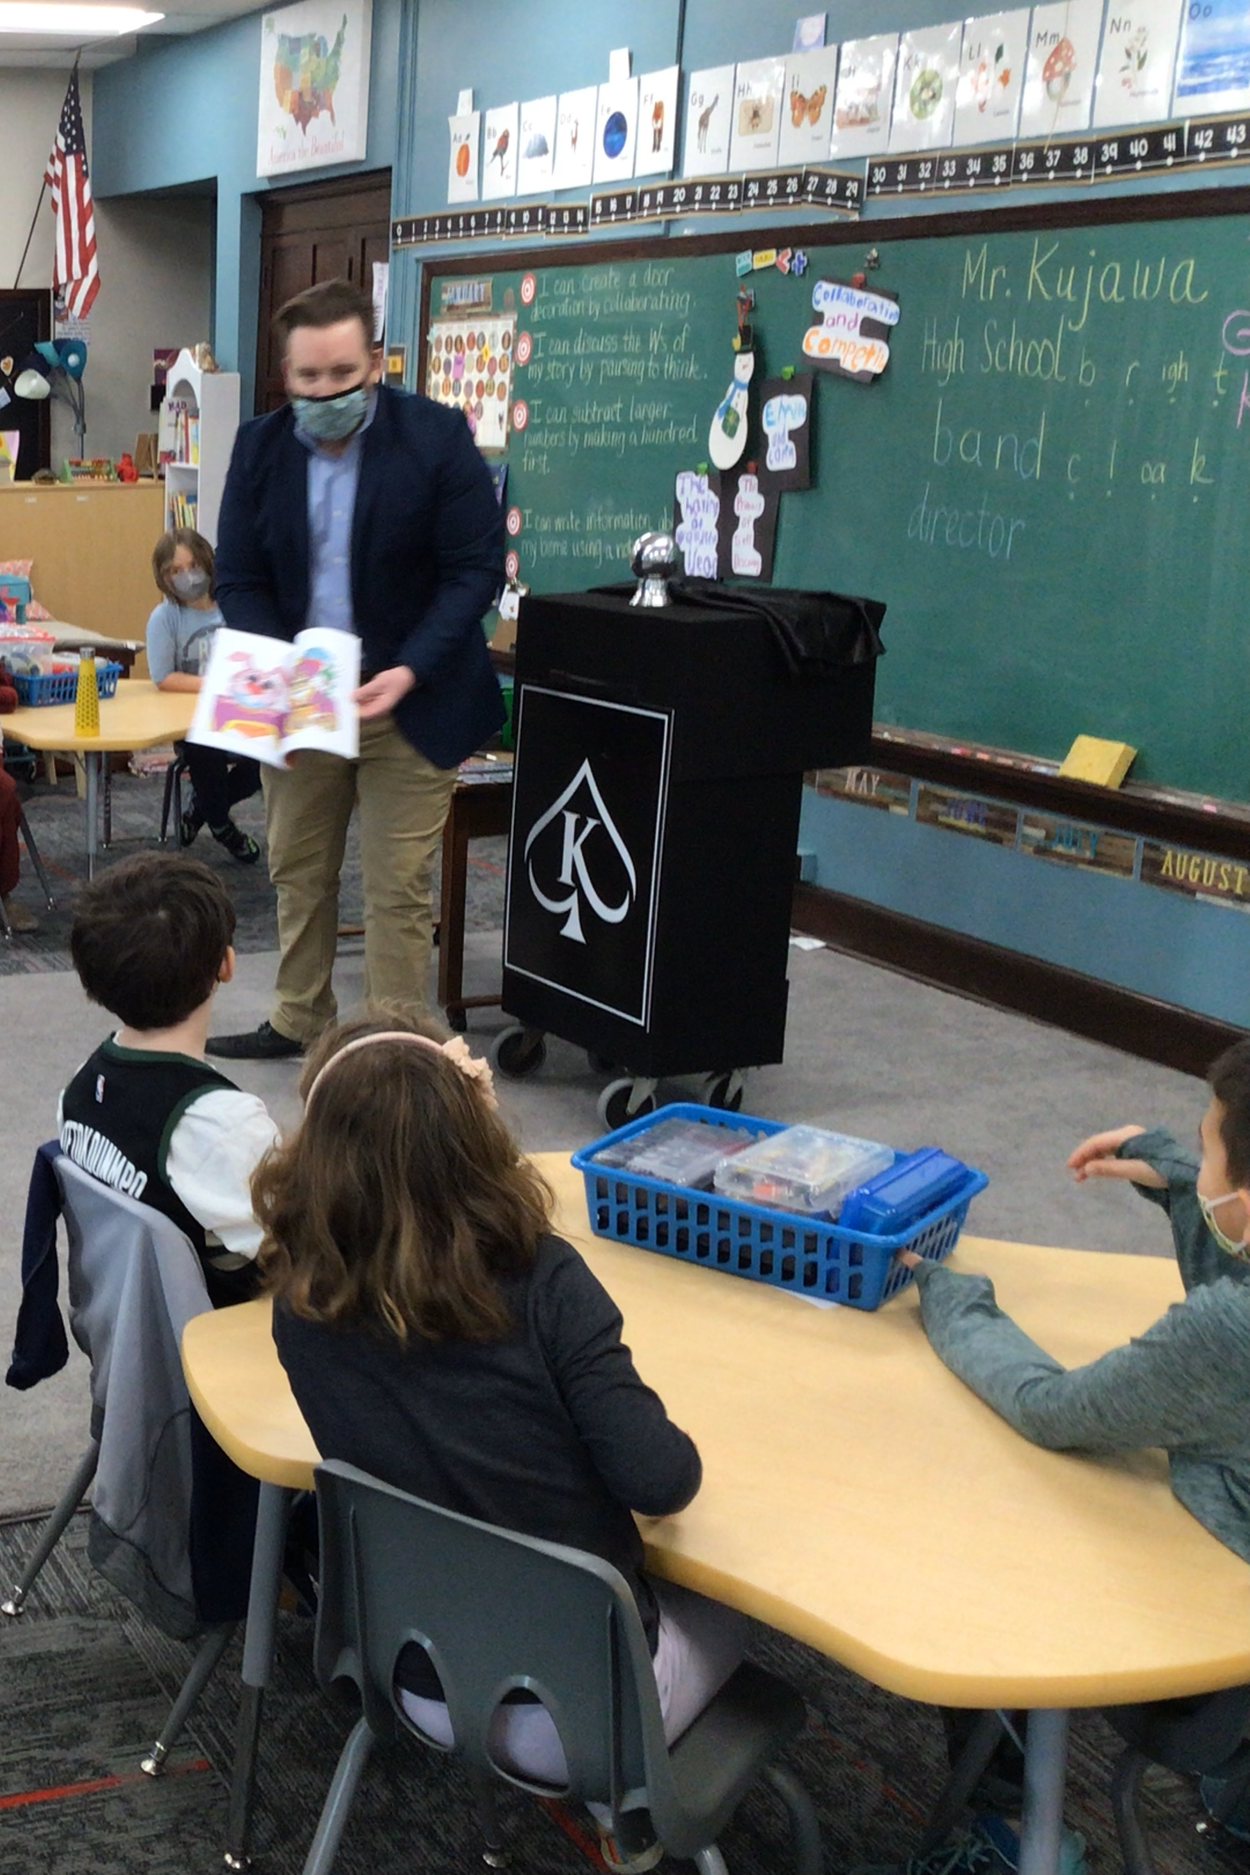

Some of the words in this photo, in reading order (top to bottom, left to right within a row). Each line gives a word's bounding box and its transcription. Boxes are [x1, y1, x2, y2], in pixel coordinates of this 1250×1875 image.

[1110, 17, 1132, 34] Nn
[1188, 3, 1212, 20] Oo
[1035, 30, 1060, 48] Mm
[643, 93, 655, 107] Ff
[691, 91, 705, 108] Gg
[396, 225, 403, 237] 0
[411, 222, 416, 234] 1
[423, 219, 429, 232] 2
[435, 219, 440, 231] 3
[459, 215, 464, 228] 5
[470, 214, 476, 228] 6
[484, 212, 490, 226] 7
[576, 208, 584, 223] 14
[595, 199, 602, 214] 15
[610, 195, 618, 207] 16
[625, 193, 633, 207] 17
[656, 190, 665, 206] 19
[673, 187, 686, 203] 20
[694, 185, 703, 201] 21
[710, 185, 722, 201] 22
[727, 183, 739, 200] 23
[747, 181, 760, 198] 24
[766, 178, 779, 196] 25
[786, 176, 798, 194] 26
[807, 174, 819, 192] 27
[825, 179, 839, 196] 28
[846, 180, 859, 199] 29
[872, 167, 886, 184] 30
[897, 163, 907, 181] 31
[918, 161, 932, 179] 32
[942, 160, 957, 178] 33
[966, 159, 981, 176] 34
[991, 154, 1007, 172] 35
[1018, 151, 1035, 170] 36
[1045, 149, 1061, 168] 37
[1072, 147, 1089, 166] 38
[1101, 141, 1119, 162] 39
[1129, 139, 1149, 157] 40
[1162, 132, 1177, 152] 41
[1194, 129, 1214, 150] 42
[1226, 125, 1247, 145] 43
[538, 273, 550, 298] I
[553, 277, 575, 297] can
[628, 270, 637, 288] a
[642, 263, 675, 288] door
[961, 242, 1012, 301] Mr.
[1028, 236, 1209, 332] Kujawa
[530, 296, 585, 323] decoration
[588, 296, 600, 322] by
[826, 312, 859, 332] and
[533, 331, 547, 360] I
[548, 336, 570, 356] can
[573, 326, 619, 356] discuss
[622, 325, 642, 352] the
[672, 322, 691, 354] of
[921, 316, 965, 388] High
[981, 313, 1067, 382] School
[527, 362, 544, 389] my
[545, 359, 576, 389] story
[579, 357, 594, 386] by
[600, 357, 647, 386] pausing
[647, 357, 660, 380] to
[529, 400, 543, 424] I
[546, 406, 568, 425] can
[571, 397, 624, 425] subtract
[629, 395, 673, 424] larger
[523, 429, 566, 449] numbers
[568, 423, 581, 457] by
[583, 423, 627, 458] making
[629, 427, 639, 447] a
[641, 413, 699, 446] hundred
[933, 397, 1047, 480] band
[523, 508, 533, 530] I
[535, 513, 551, 531] can
[554, 509, 582, 532] write
[584, 506, 651, 532] information
[907, 481, 1026, 559] director
[521, 539, 538, 568] my
[571, 539, 603, 569] using
[845, 767, 880, 796] MAY
[1049, 823, 1099, 860] JULY
[1159, 849, 1249, 895] AUGUST
